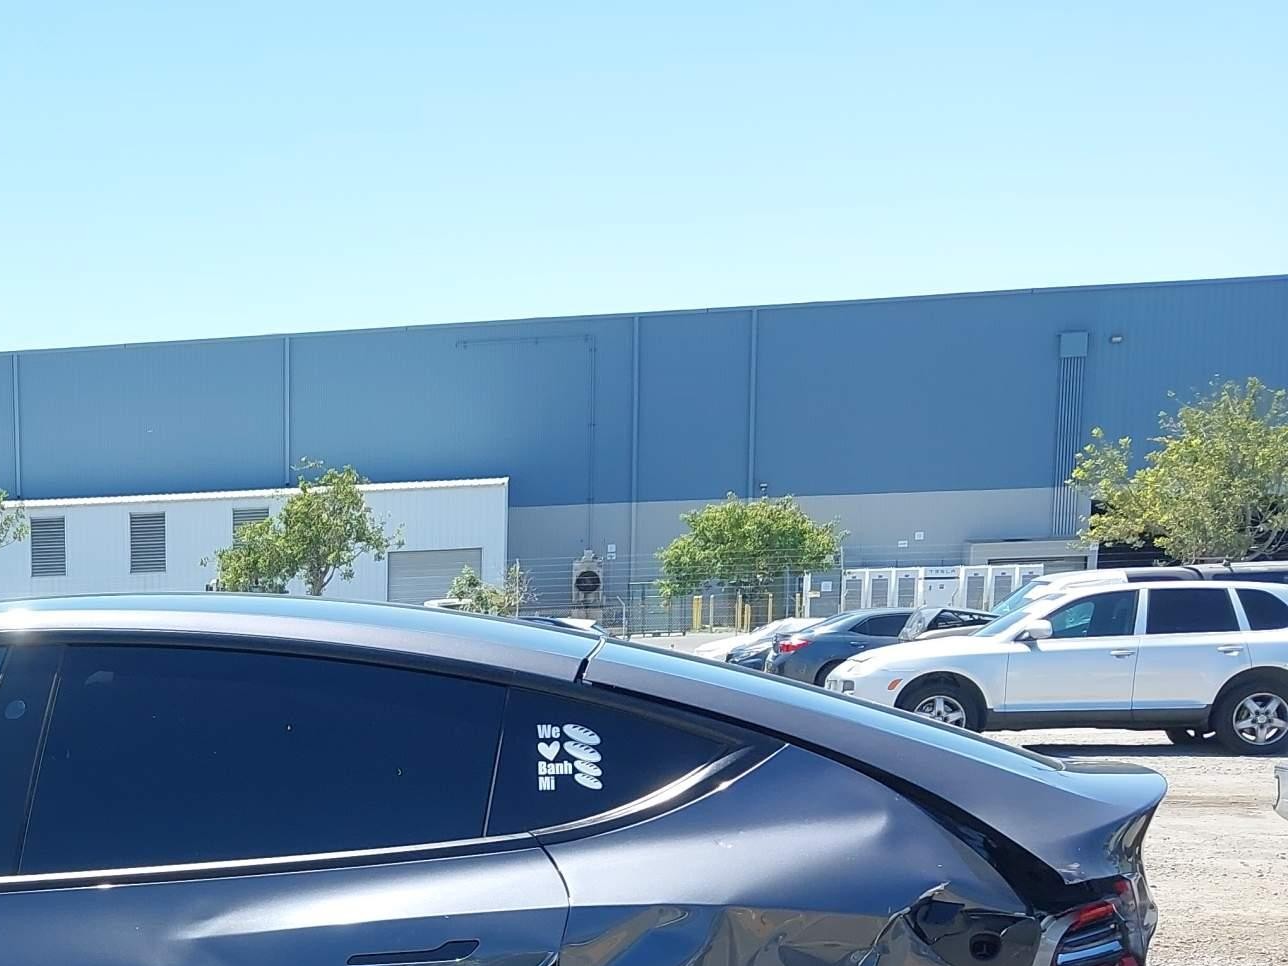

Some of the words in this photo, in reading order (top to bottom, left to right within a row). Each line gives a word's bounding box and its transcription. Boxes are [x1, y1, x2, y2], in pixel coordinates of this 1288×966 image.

[536, 724, 561, 739] We
[537, 760, 573, 775] Banh
[538, 776, 556, 791] Mi
